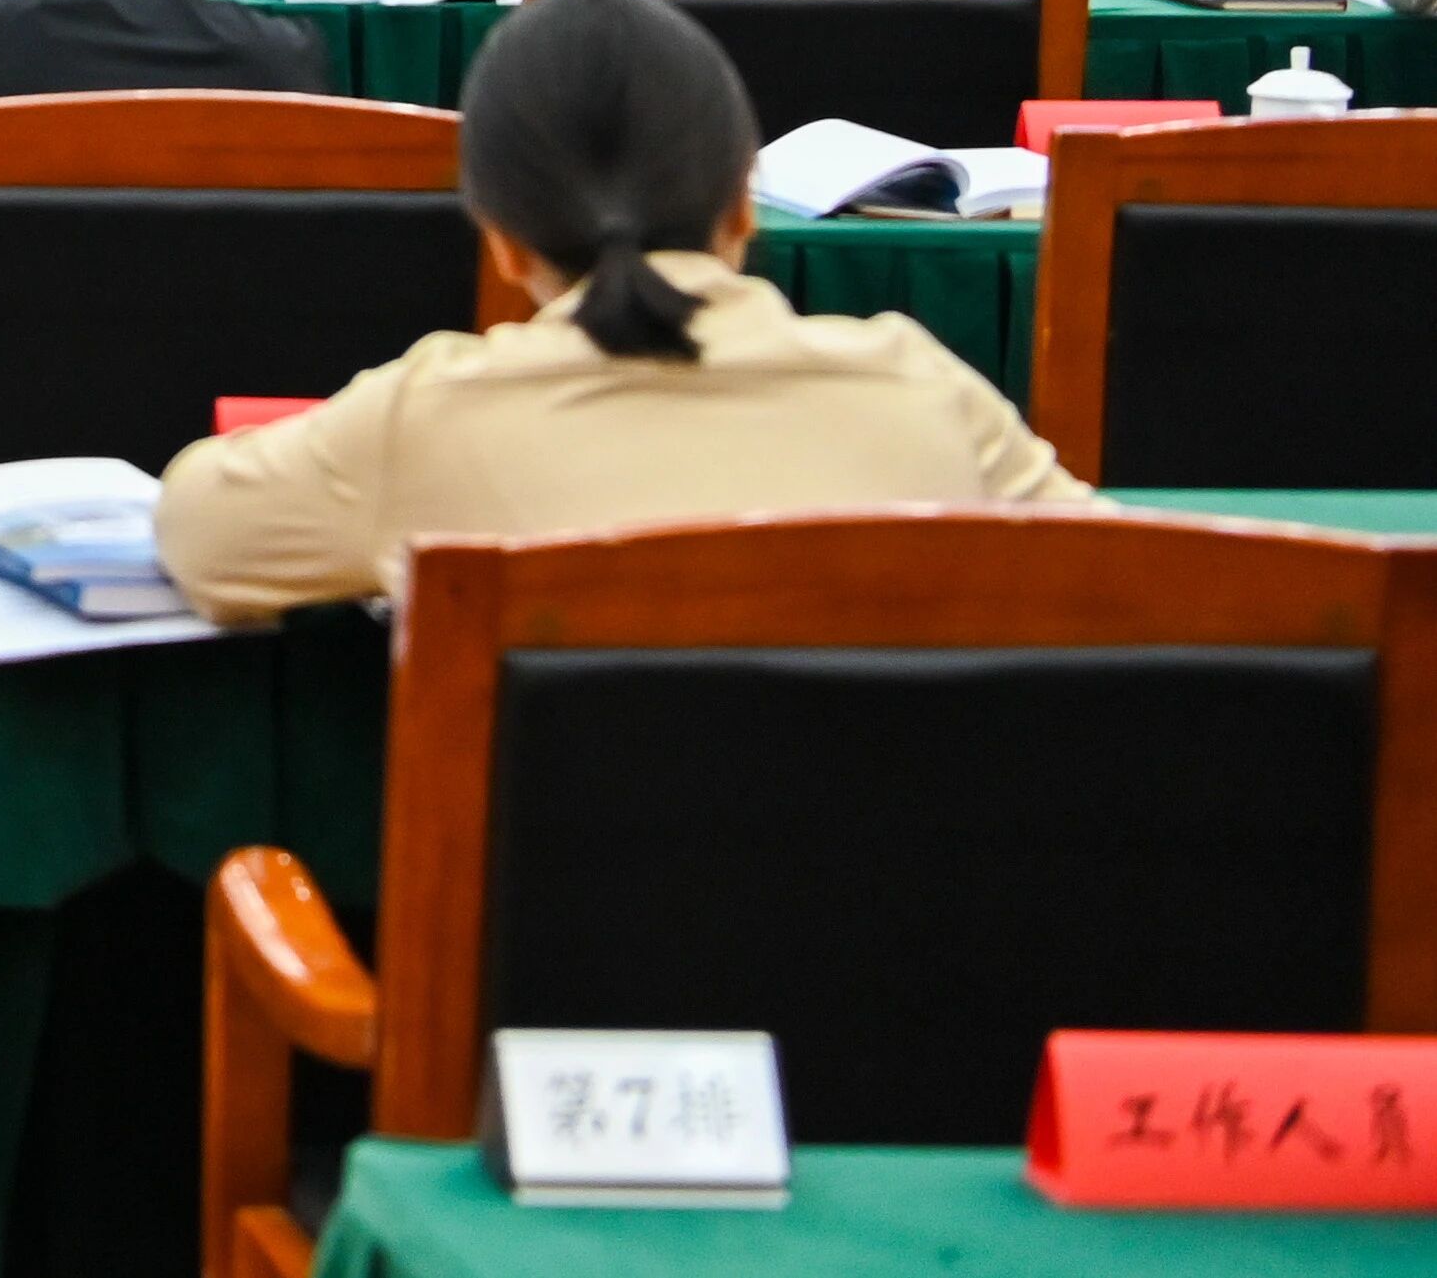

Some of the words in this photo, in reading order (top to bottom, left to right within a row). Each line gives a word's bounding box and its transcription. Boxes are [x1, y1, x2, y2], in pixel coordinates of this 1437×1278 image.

[544, 1069, 748, 1147] 第7排
[1106, 1078, 1418, 1169] 工作人员
